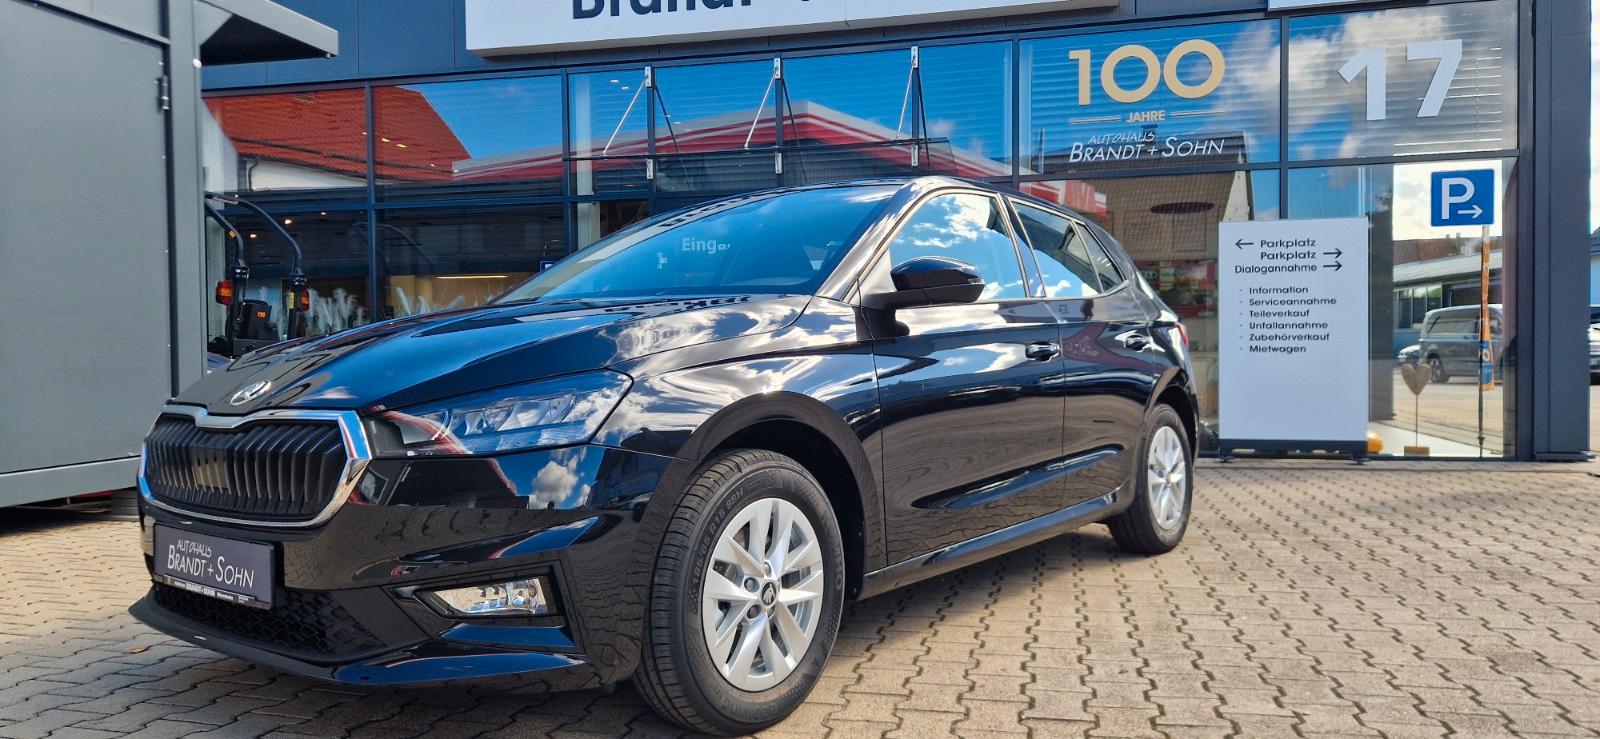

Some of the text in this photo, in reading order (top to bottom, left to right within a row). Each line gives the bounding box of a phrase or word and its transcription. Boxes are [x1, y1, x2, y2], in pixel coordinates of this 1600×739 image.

[1069, 39, 1226, 105] 100
[1338, 39, 1462, 120] 17
[1126, 110, 1166, 123] JAHRE
[1088, 131, 1155, 145] AUTOHAUS
[1069, 136, 1225, 163] BRANDT + SOHN
[1442, 177, 1474, 219] P
[1260, 238, 1316, 248] Parkplatz
[1260, 251, 1317, 261] Parkplatz
[1234, 264, 1318, 275] Dialogannahme
[1249, 286, 1309, 294] Information
[1249, 298, 1337, 306] Serviceannahme
[1249, 309, 1310, 318] Teileverkauf
[1249, 321, 1328, 329] Unfallannahme
[1249, 333, 1330, 341] Zubehörverkauf
[1249, 345, 1307, 354] Mietwagen
[176, 540, 212, 558] AUTOHAUS
[167, 545, 254, 589] BRANDT + SOHN
